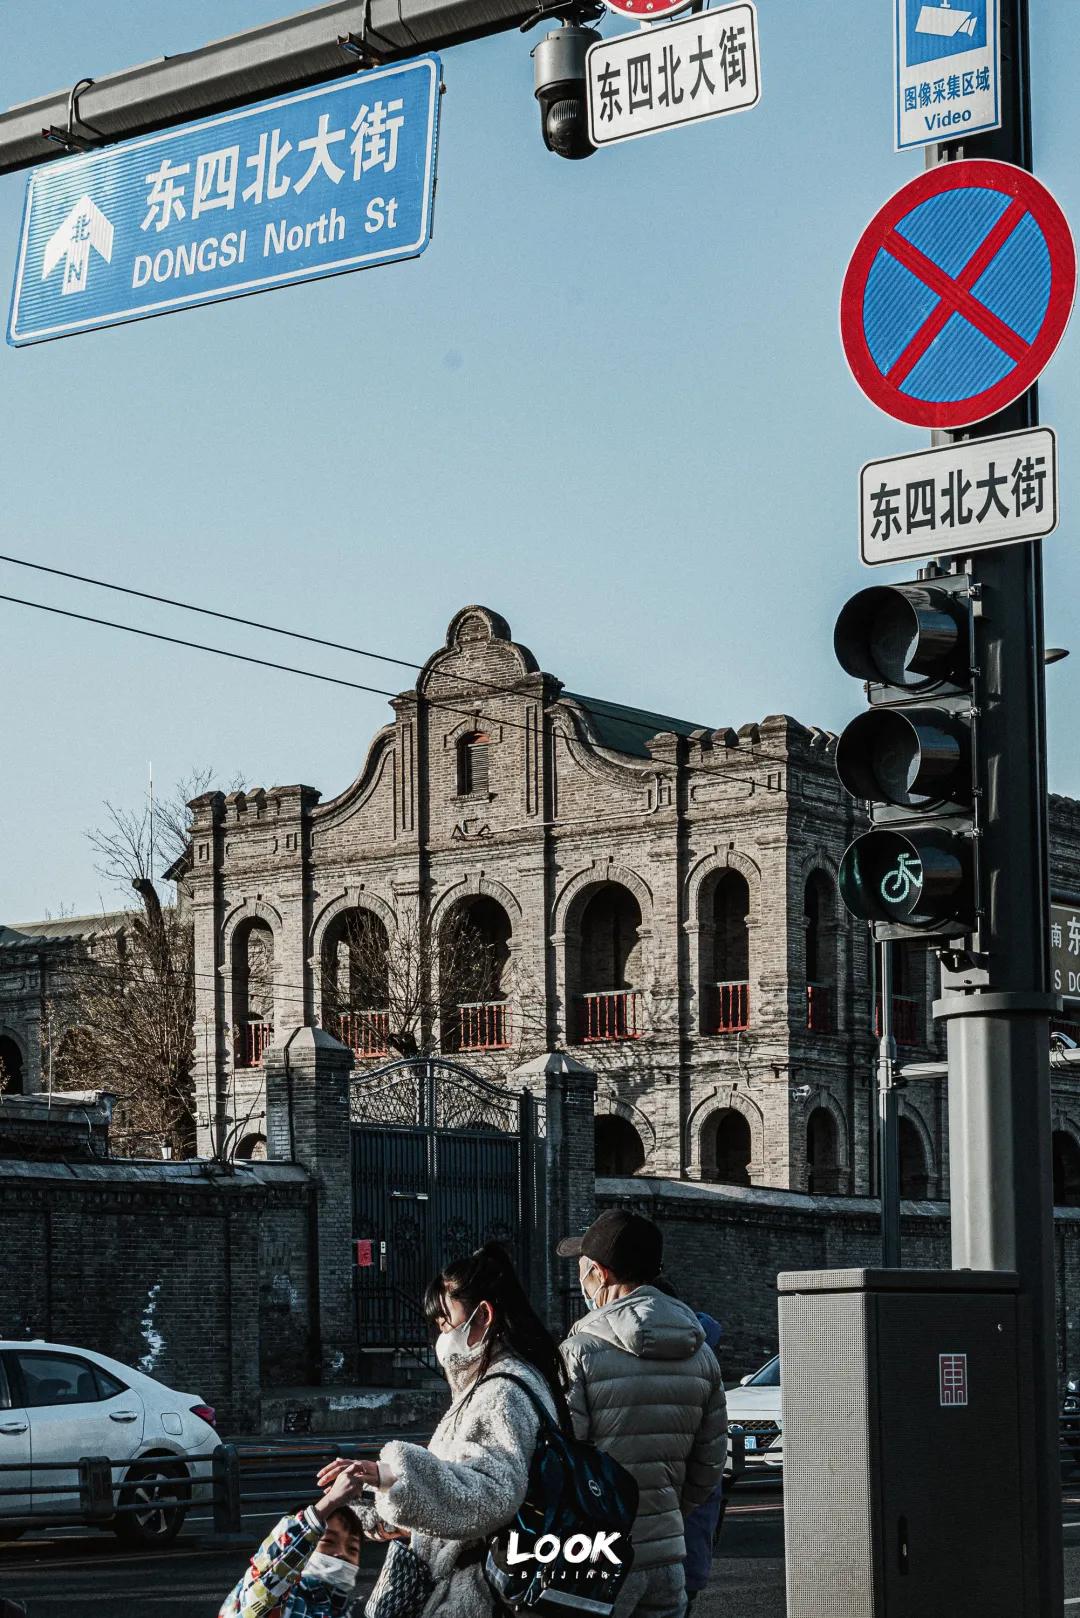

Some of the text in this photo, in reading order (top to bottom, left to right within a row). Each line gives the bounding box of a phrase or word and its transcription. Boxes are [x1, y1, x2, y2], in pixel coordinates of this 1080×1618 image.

[597, 26, 746, 122] 东四北大街
[904, 66, 990, 112] 图像采集区域
[924, 109, 972, 131] Video
[140, 98, 405, 232] 东四北大街
[70, 213, 91, 243] 北
[131, 197, 398, 289] DONGSI North St
[68, 258, 84, 284] N
[870, 456, 1047, 542] 东四北大街
[1051, 922, 1062, 948] 南
[1054, 969, 1062, 990] S
